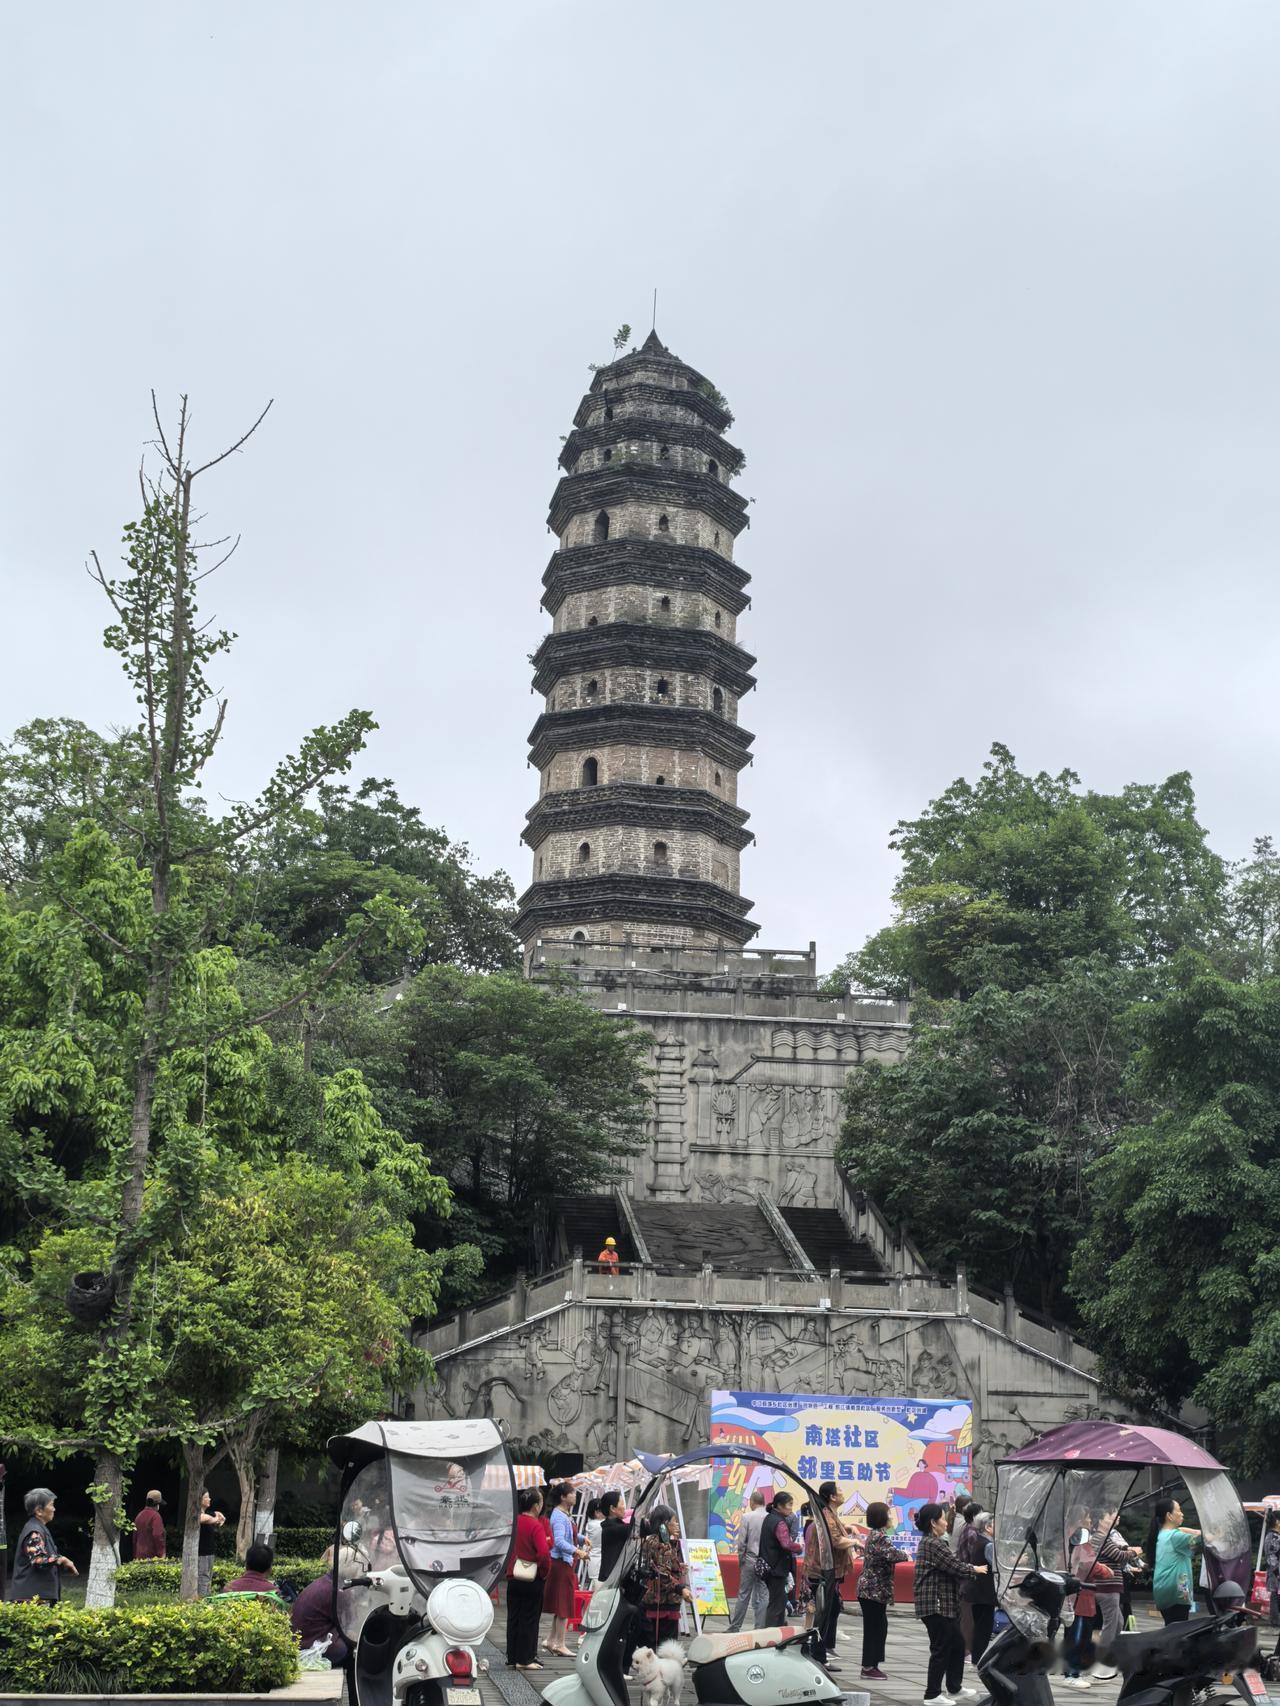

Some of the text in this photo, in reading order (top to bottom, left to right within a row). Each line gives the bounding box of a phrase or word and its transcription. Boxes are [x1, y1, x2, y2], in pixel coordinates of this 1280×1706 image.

[805, 1424, 879, 1448] 南塔社区
[798, 1455, 891, 1482] 邻里互助节
